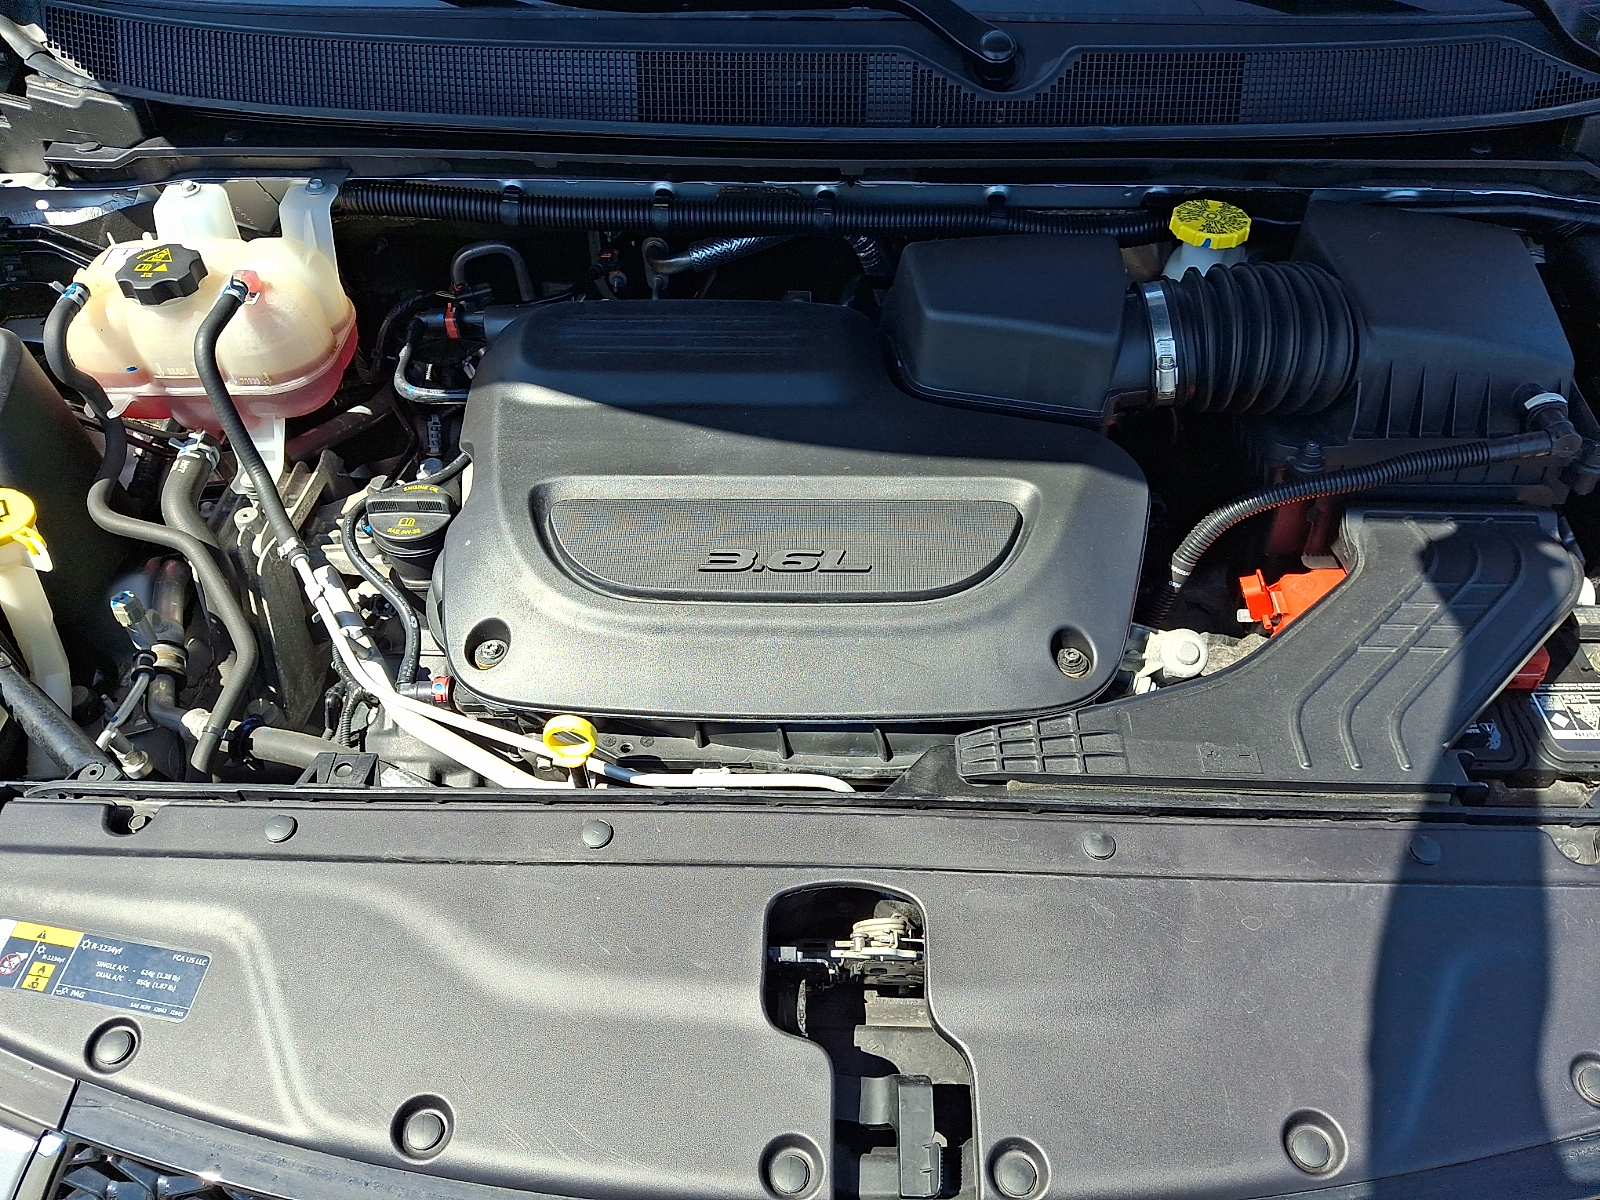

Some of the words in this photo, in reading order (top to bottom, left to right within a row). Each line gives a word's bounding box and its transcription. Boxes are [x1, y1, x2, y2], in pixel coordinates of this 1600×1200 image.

[403, 484, 429, 492] ENGINE
[698, 548, 873, 573] 3.6L
[91, 942, 123, 955] R-1234yf
[172, 954, 185, 962] FCA
[195, 958, 208, 966] LLC
[95, 961, 116, 970] SINGLE
[116, 965, 129, 973] A/C
[95, 971, 112, 980] DUAL
[112, 974, 124, 982] A/C
[70, 989, 86, 999] PAG
